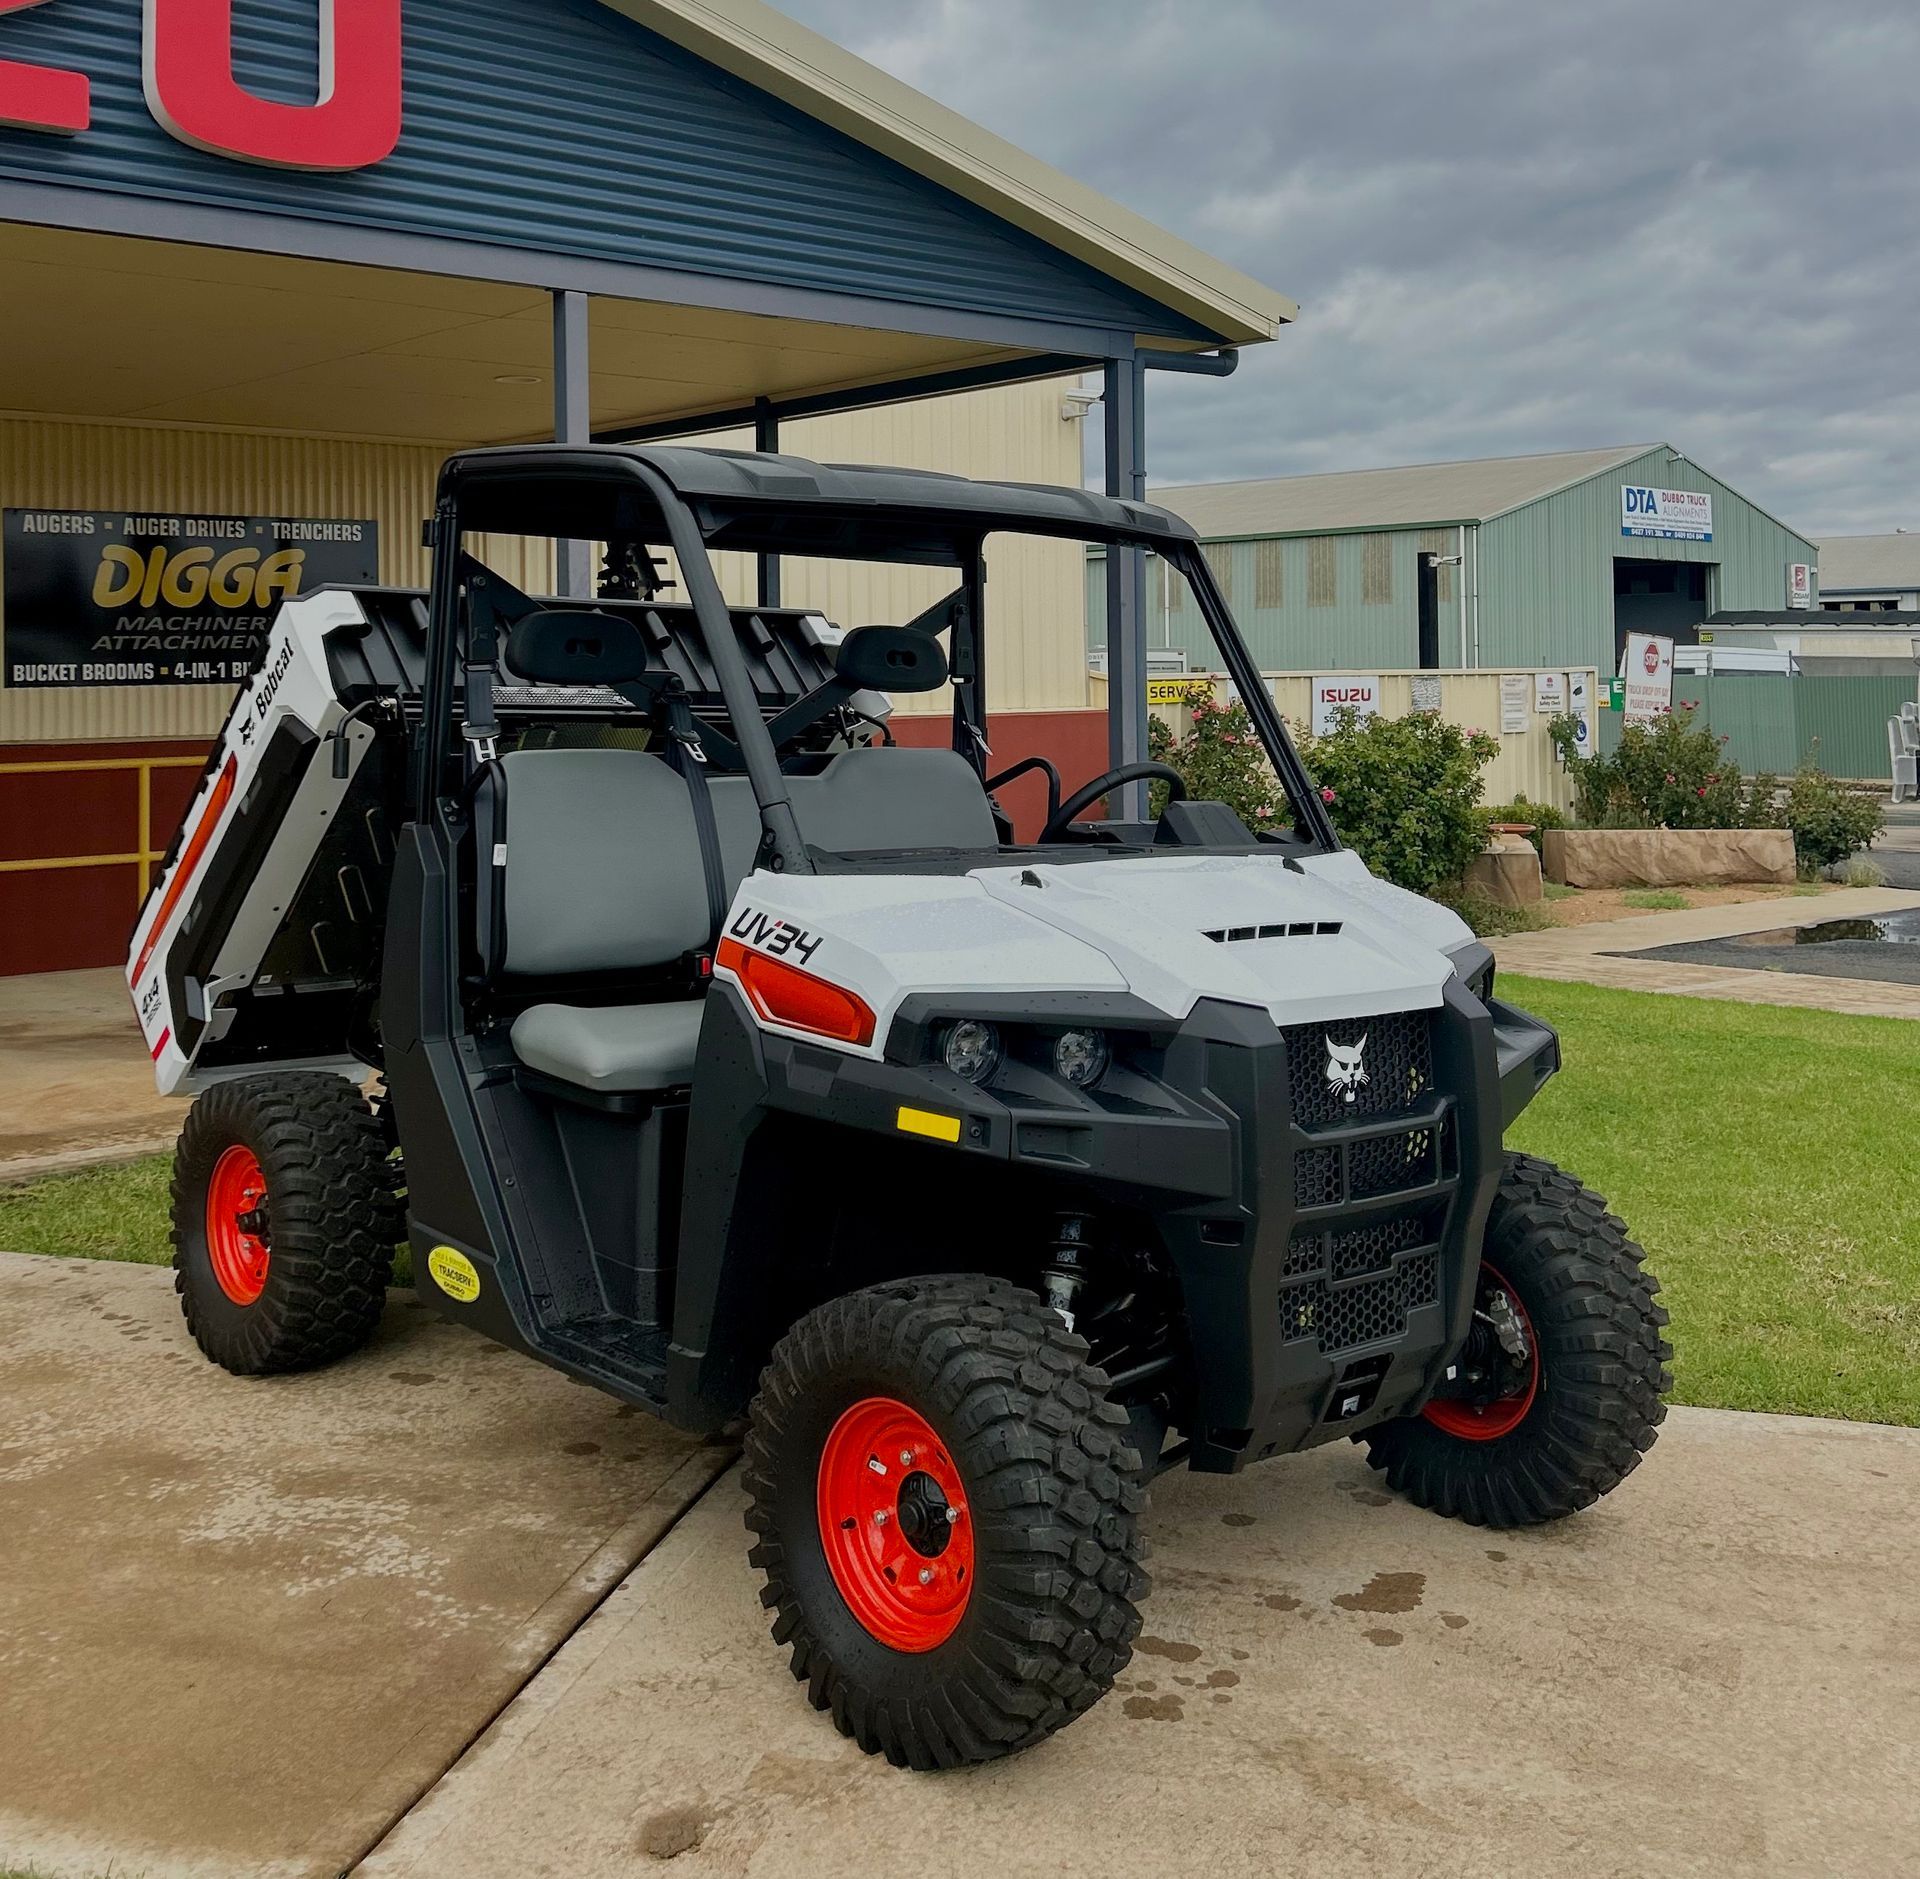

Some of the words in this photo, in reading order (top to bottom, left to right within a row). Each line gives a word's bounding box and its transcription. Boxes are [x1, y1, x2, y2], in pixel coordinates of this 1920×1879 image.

[1626, 488, 1658, 514] DTA
[1662, 492, 1685, 504] DUBBO
[1687, 495, 1707, 506] TRUCK
[1663, 506, 1708, 519] ALIGNMENTS
[23, 514, 95, 534] AUGERS
[123, 517, 180, 537] AUGER
[186, 520, 245, 538] DRIVES
[271, 522, 362, 541] TRENCHERS
[92, 544, 306, 608] DIGGA
[115, 616, 271, 631] MACHINER
[13, 664, 78, 682] BUCKET
[82, 662, 154, 681] BROOMS
[174, 662, 226, 679] 4-IN-1
[255, 636, 295, 720] Bobcat
[1321, 688, 1371, 702] ISUZU
[730, 907, 824, 965] UV34
